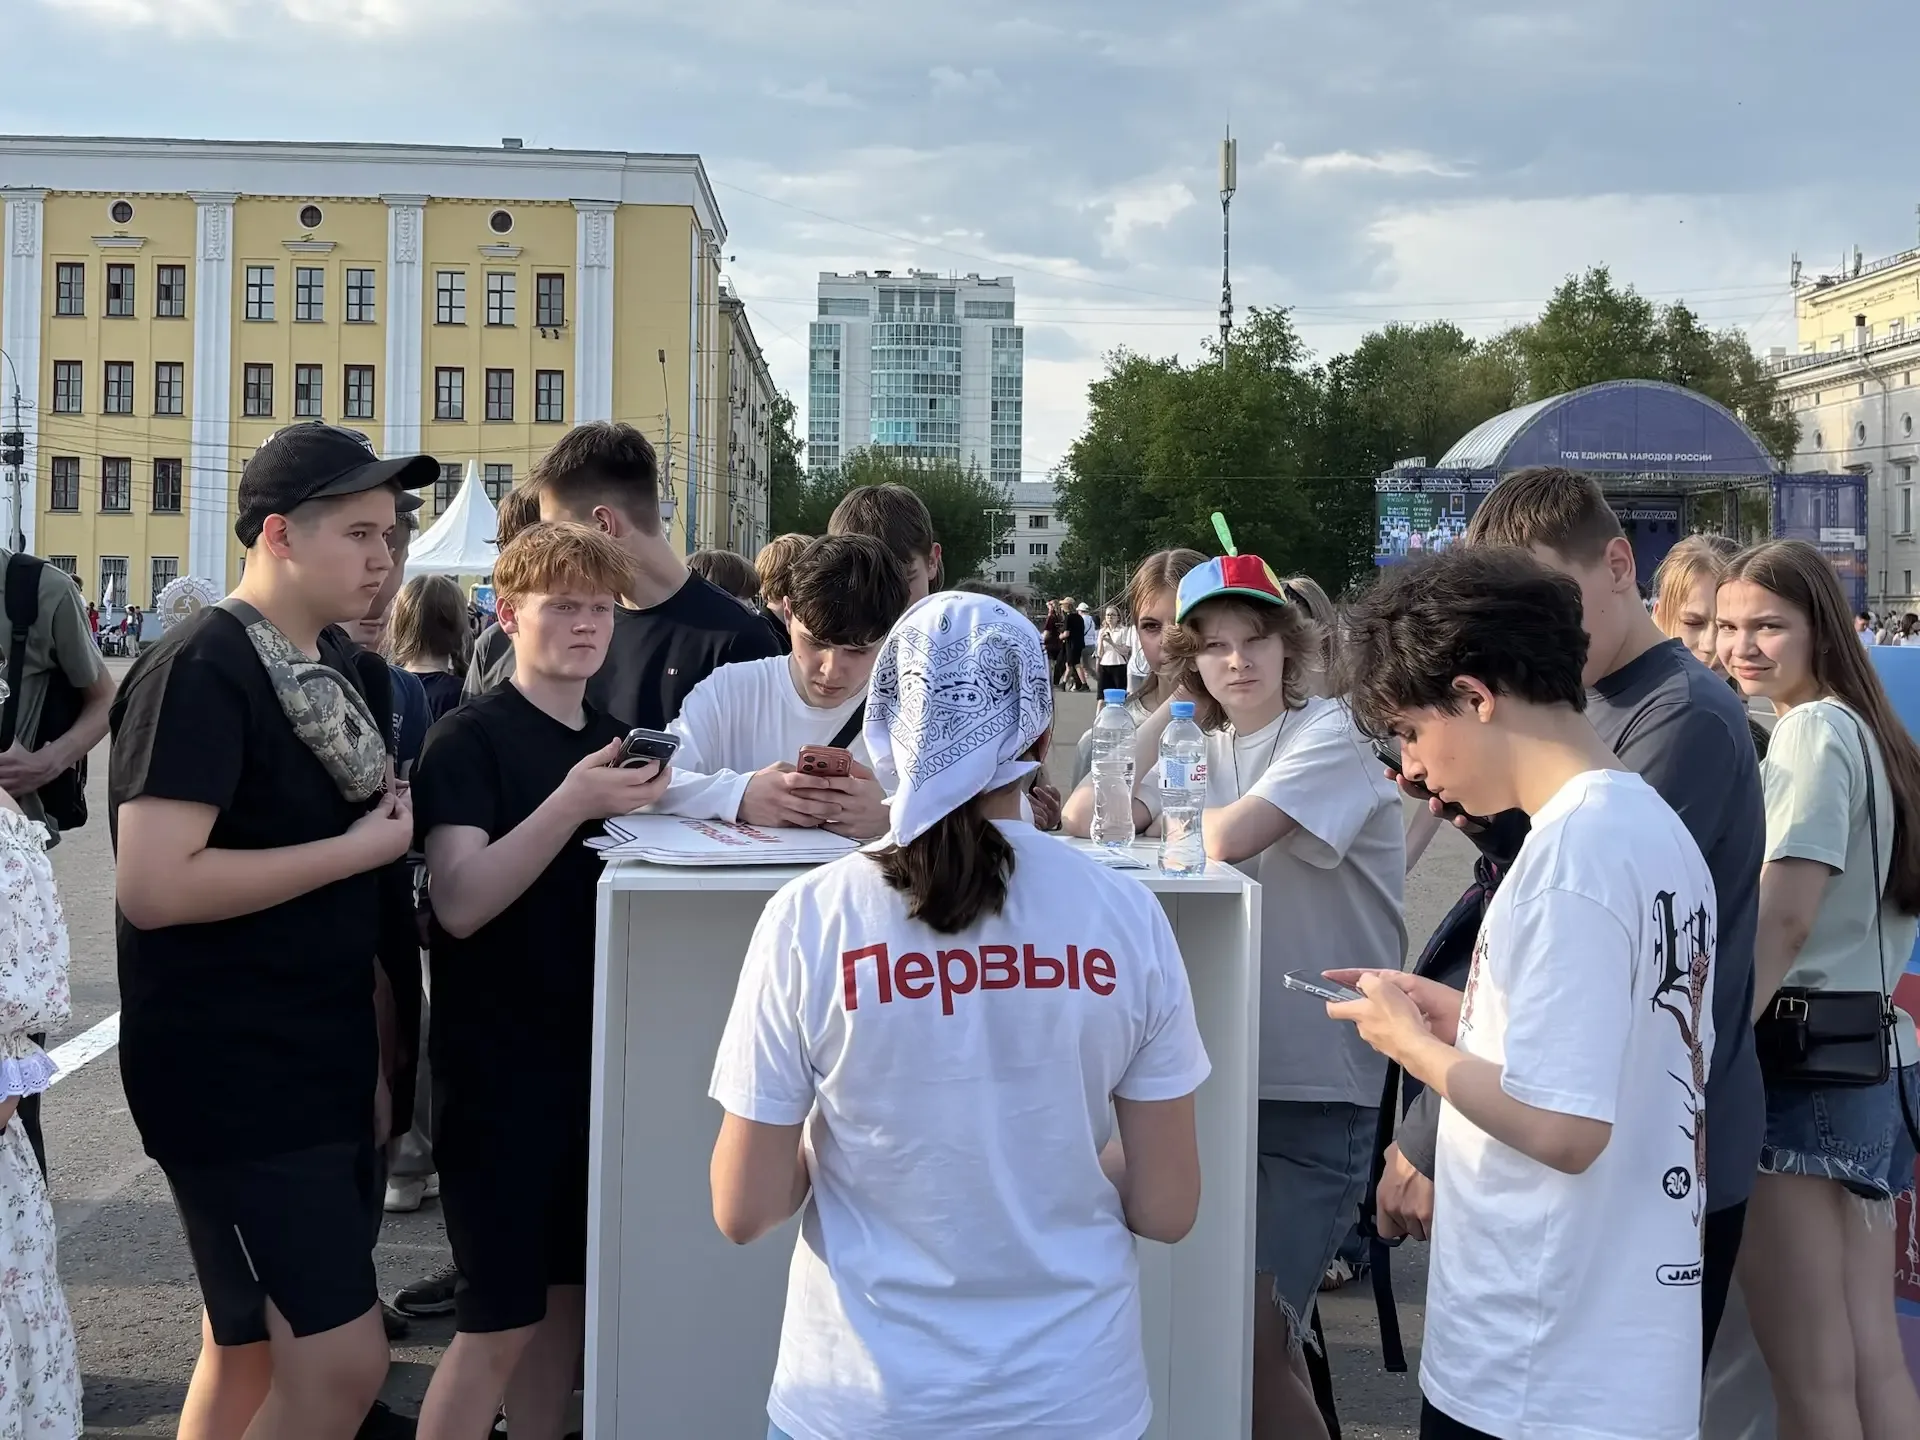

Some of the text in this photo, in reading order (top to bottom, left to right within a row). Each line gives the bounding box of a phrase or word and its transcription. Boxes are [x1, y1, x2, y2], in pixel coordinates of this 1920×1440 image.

[1560, 451, 1712, 462] ГОД ЕДИНСТВА НАРОДОВ РОССИИ
[842, 942, 1117, 1016] Первые
[1667, 1267, 1701, 1281] JAP
